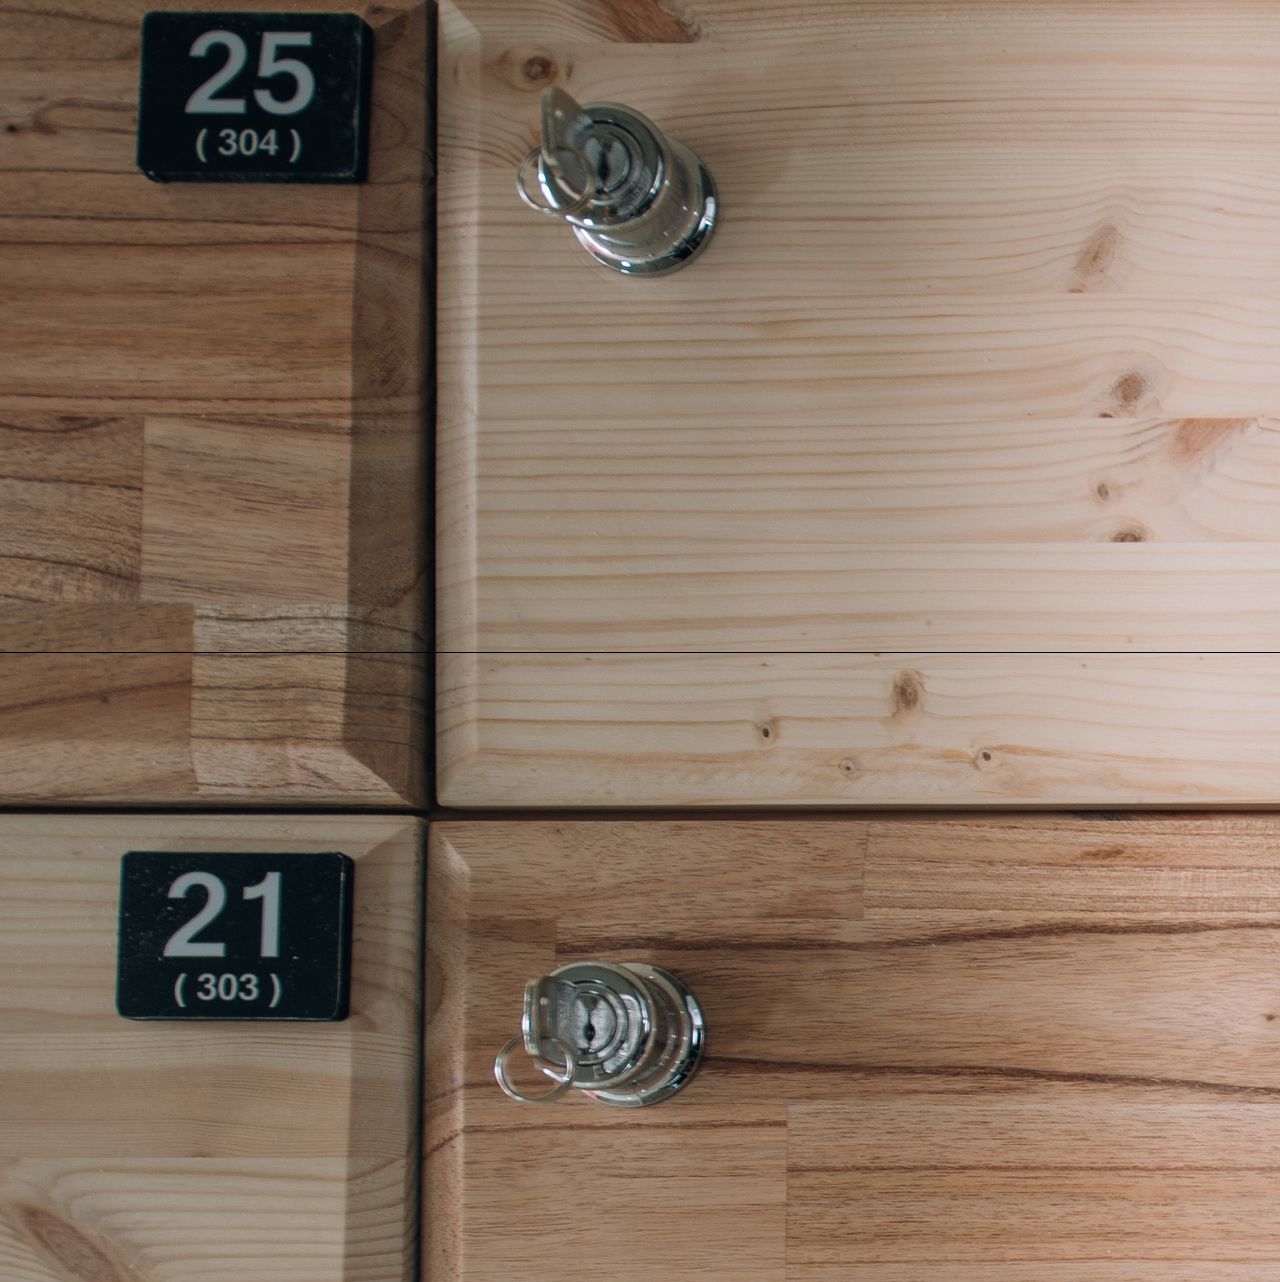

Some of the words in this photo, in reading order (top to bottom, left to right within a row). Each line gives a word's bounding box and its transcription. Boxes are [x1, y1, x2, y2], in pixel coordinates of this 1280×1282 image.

[184, 30, 316, 116] 25
[195, 128, 302, 164] (304)
[163, 872, 280, 957] 21
[174, 973, 282, 1007] (303)
